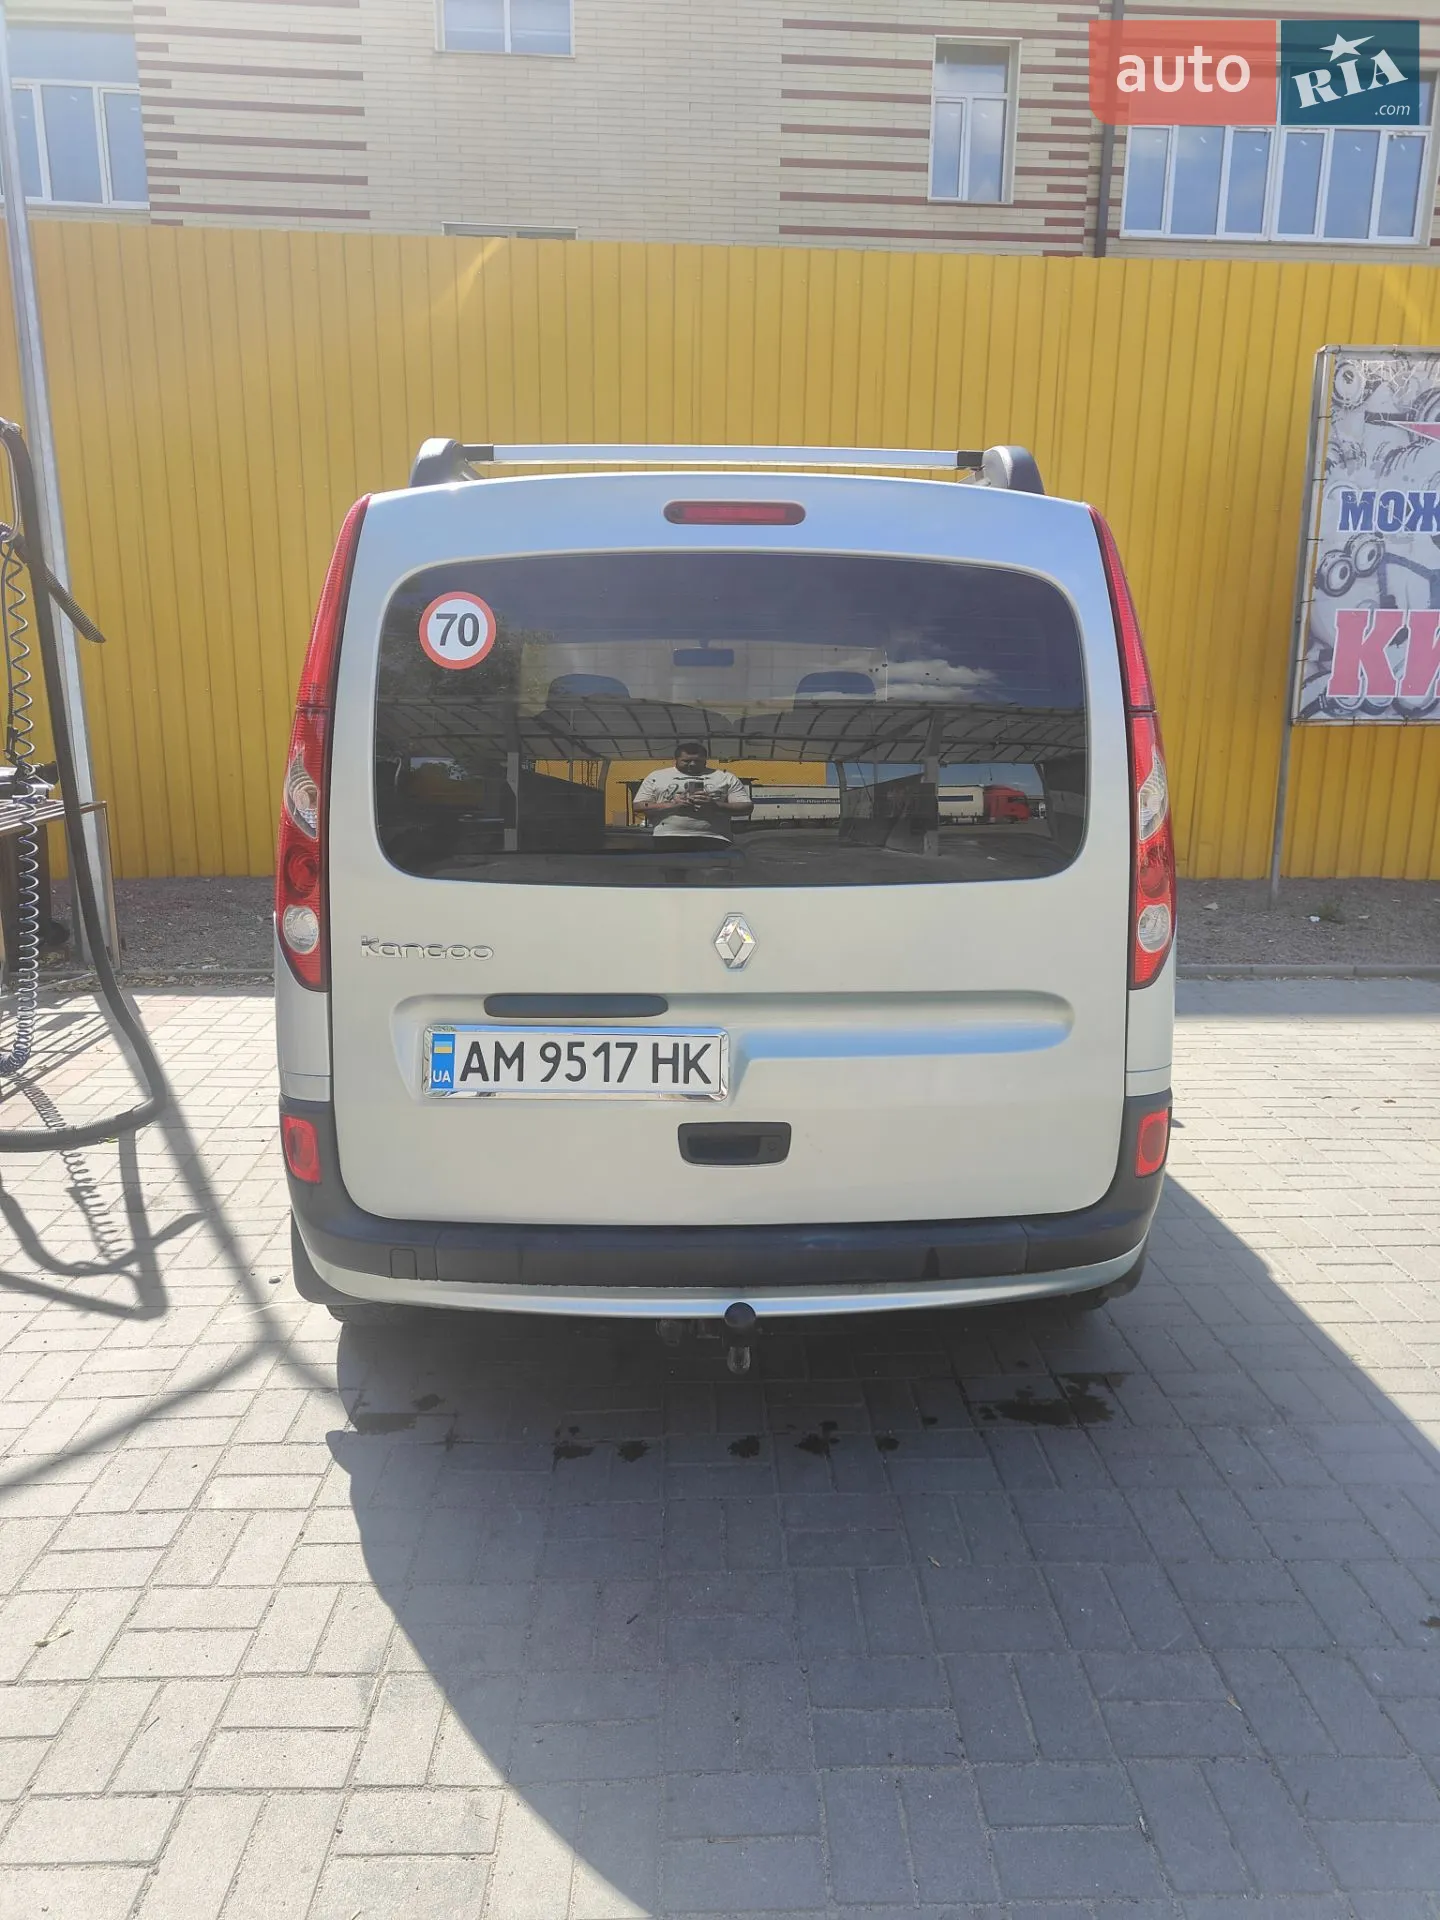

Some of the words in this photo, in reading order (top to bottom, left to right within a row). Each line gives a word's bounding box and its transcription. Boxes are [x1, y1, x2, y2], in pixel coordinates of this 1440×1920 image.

[436, 612, 480, 647] 70
[360, 934, 495, 961] Kangoo
[432, 1070, 452, 1083] UA
[459, 1040, 524, 1082] AM
[539, 1041, 639, 1083] 9517
[651, 1042, 712, 1084] HK
